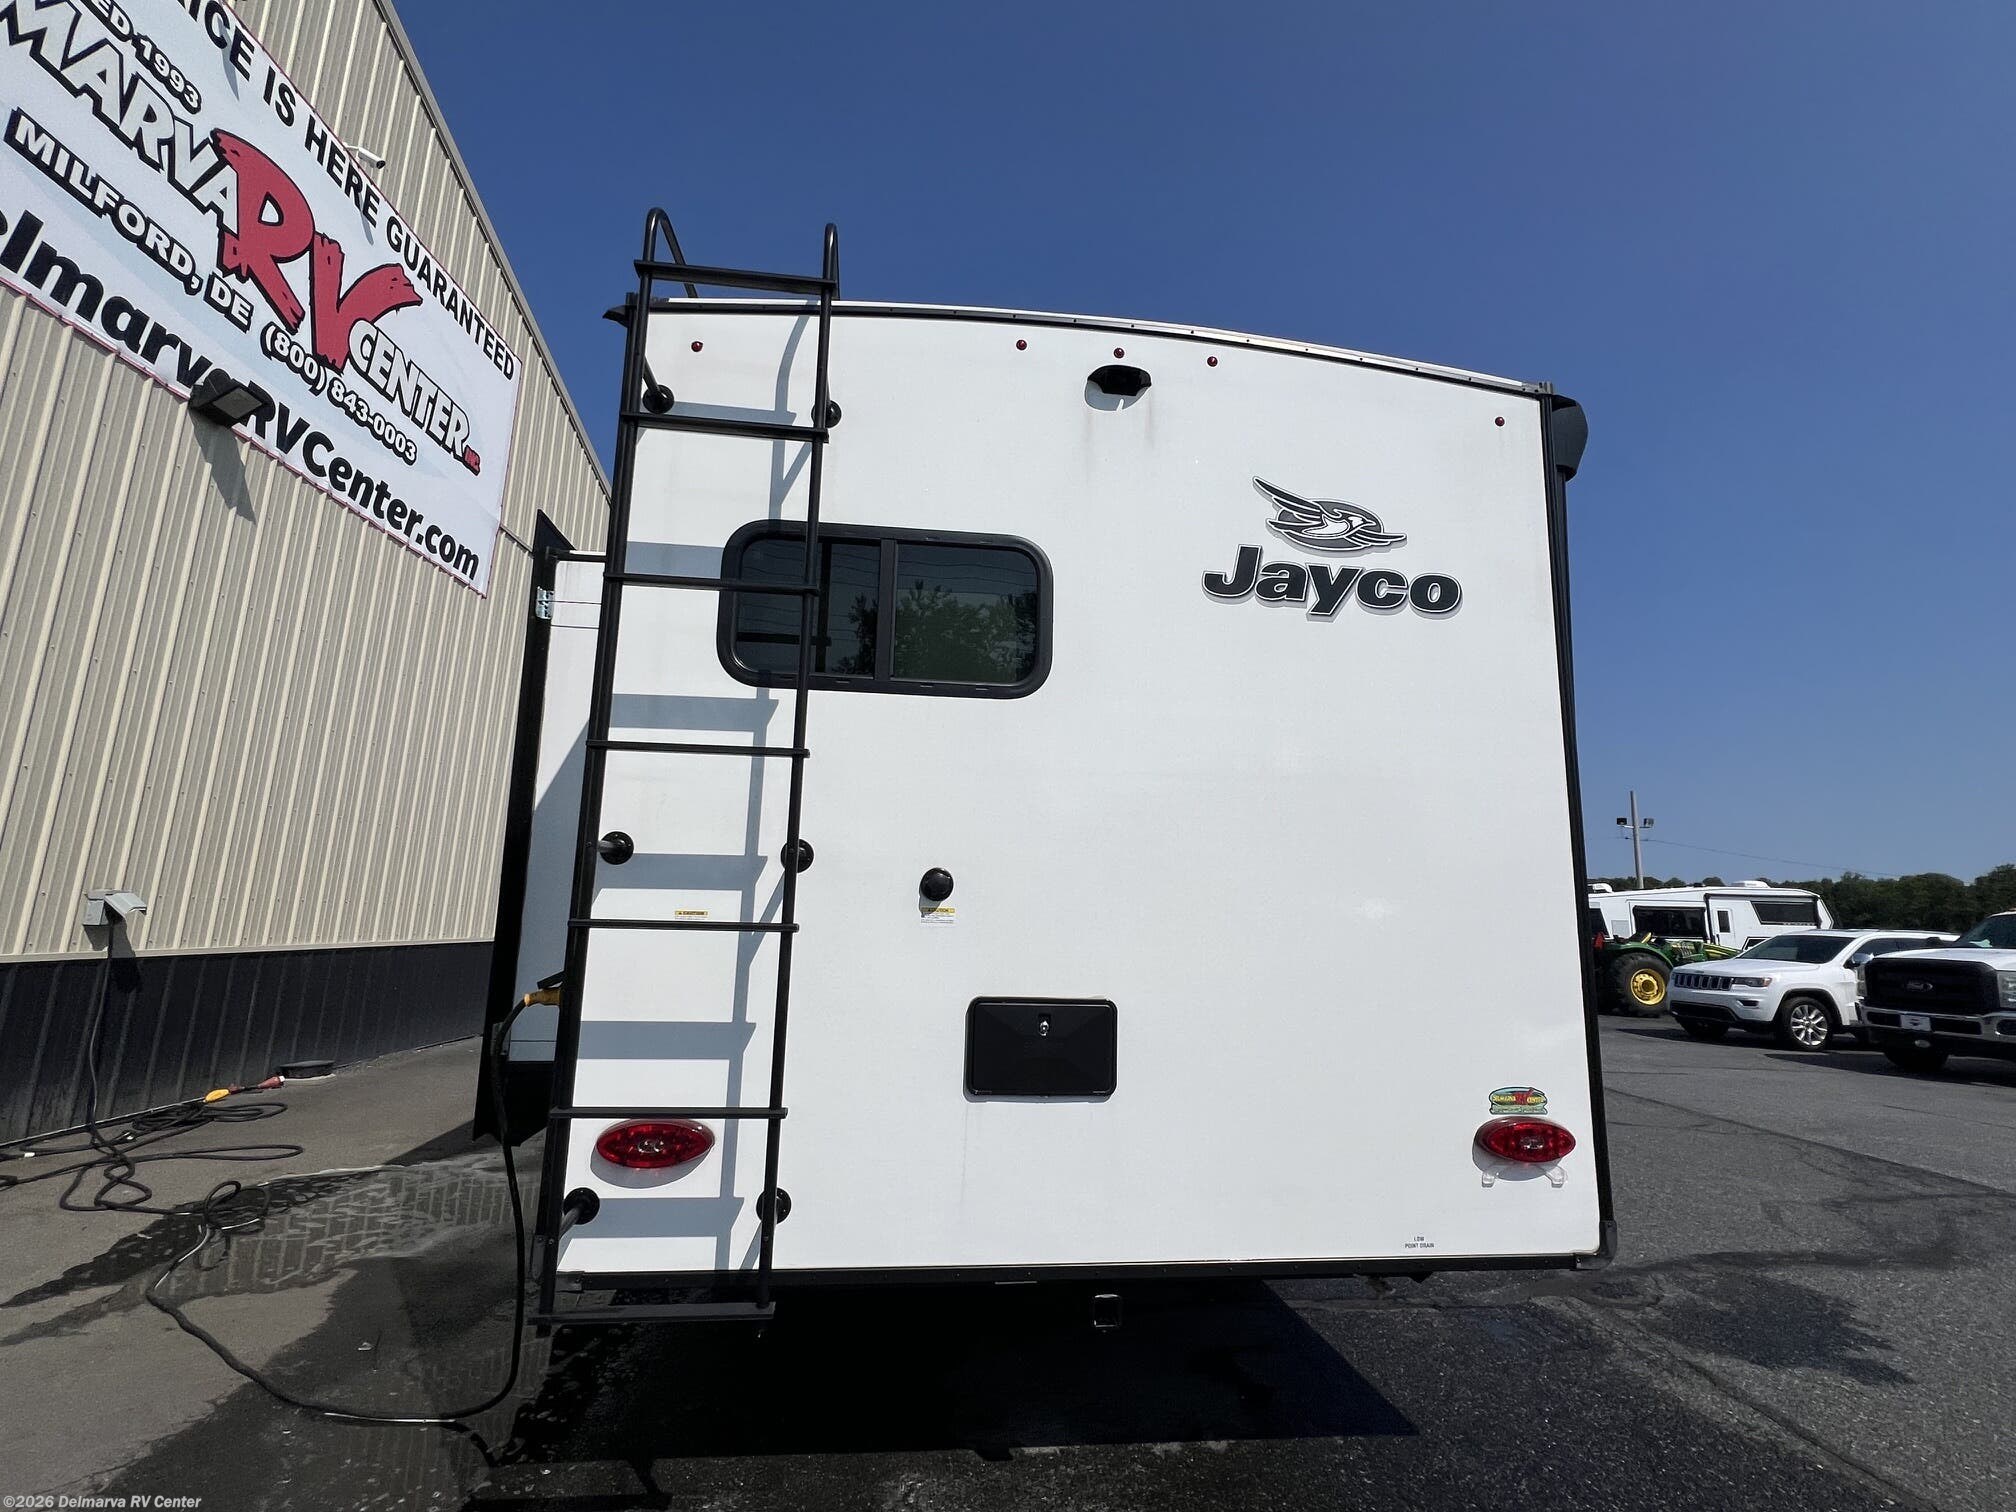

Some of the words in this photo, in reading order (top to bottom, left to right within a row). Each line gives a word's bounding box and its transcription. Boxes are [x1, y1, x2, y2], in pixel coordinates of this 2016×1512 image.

[135, 36, 201, 113] 1993
[8, 110, 202, 292] MILFORD,
[205, 270, 253, 332] DE
[211, 128, 423, 374] RV
[349, 319, 470, 462] CENTER
[263, 66, 297, 127] IS
[304, 115, 381, 228] HERE
[387, 215, 515, 381] GUARANTEED
[262, 322, 327, 394] (800)
[330, 376, 417, 464] 843-0003
[1202, 544, 1463, 617] Jayco
